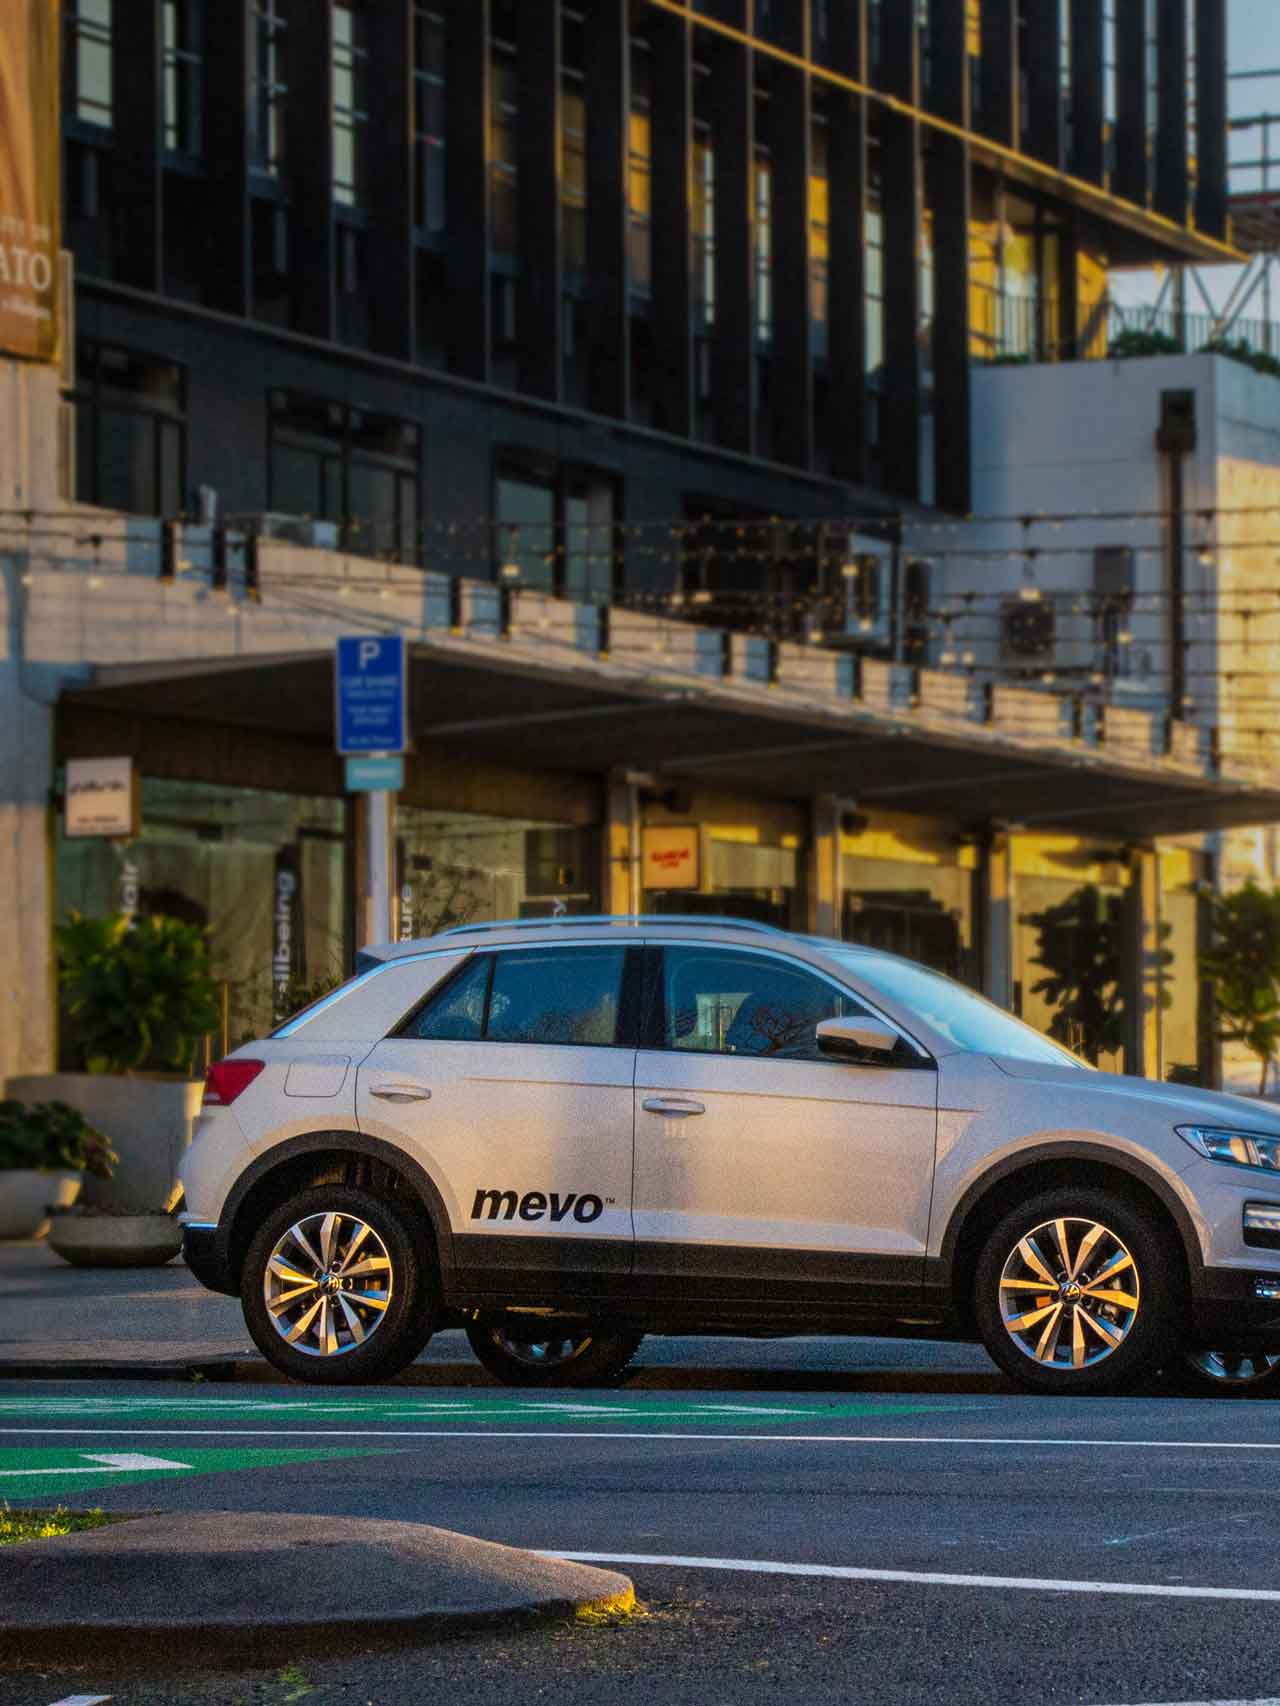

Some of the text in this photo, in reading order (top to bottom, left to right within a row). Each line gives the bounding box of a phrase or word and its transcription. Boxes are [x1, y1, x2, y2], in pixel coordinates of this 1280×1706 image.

[358, 640, 382, 670] P
[273, 871, 296, 1021] ellbeing
[471, 1188, 603, 1224] mevo
